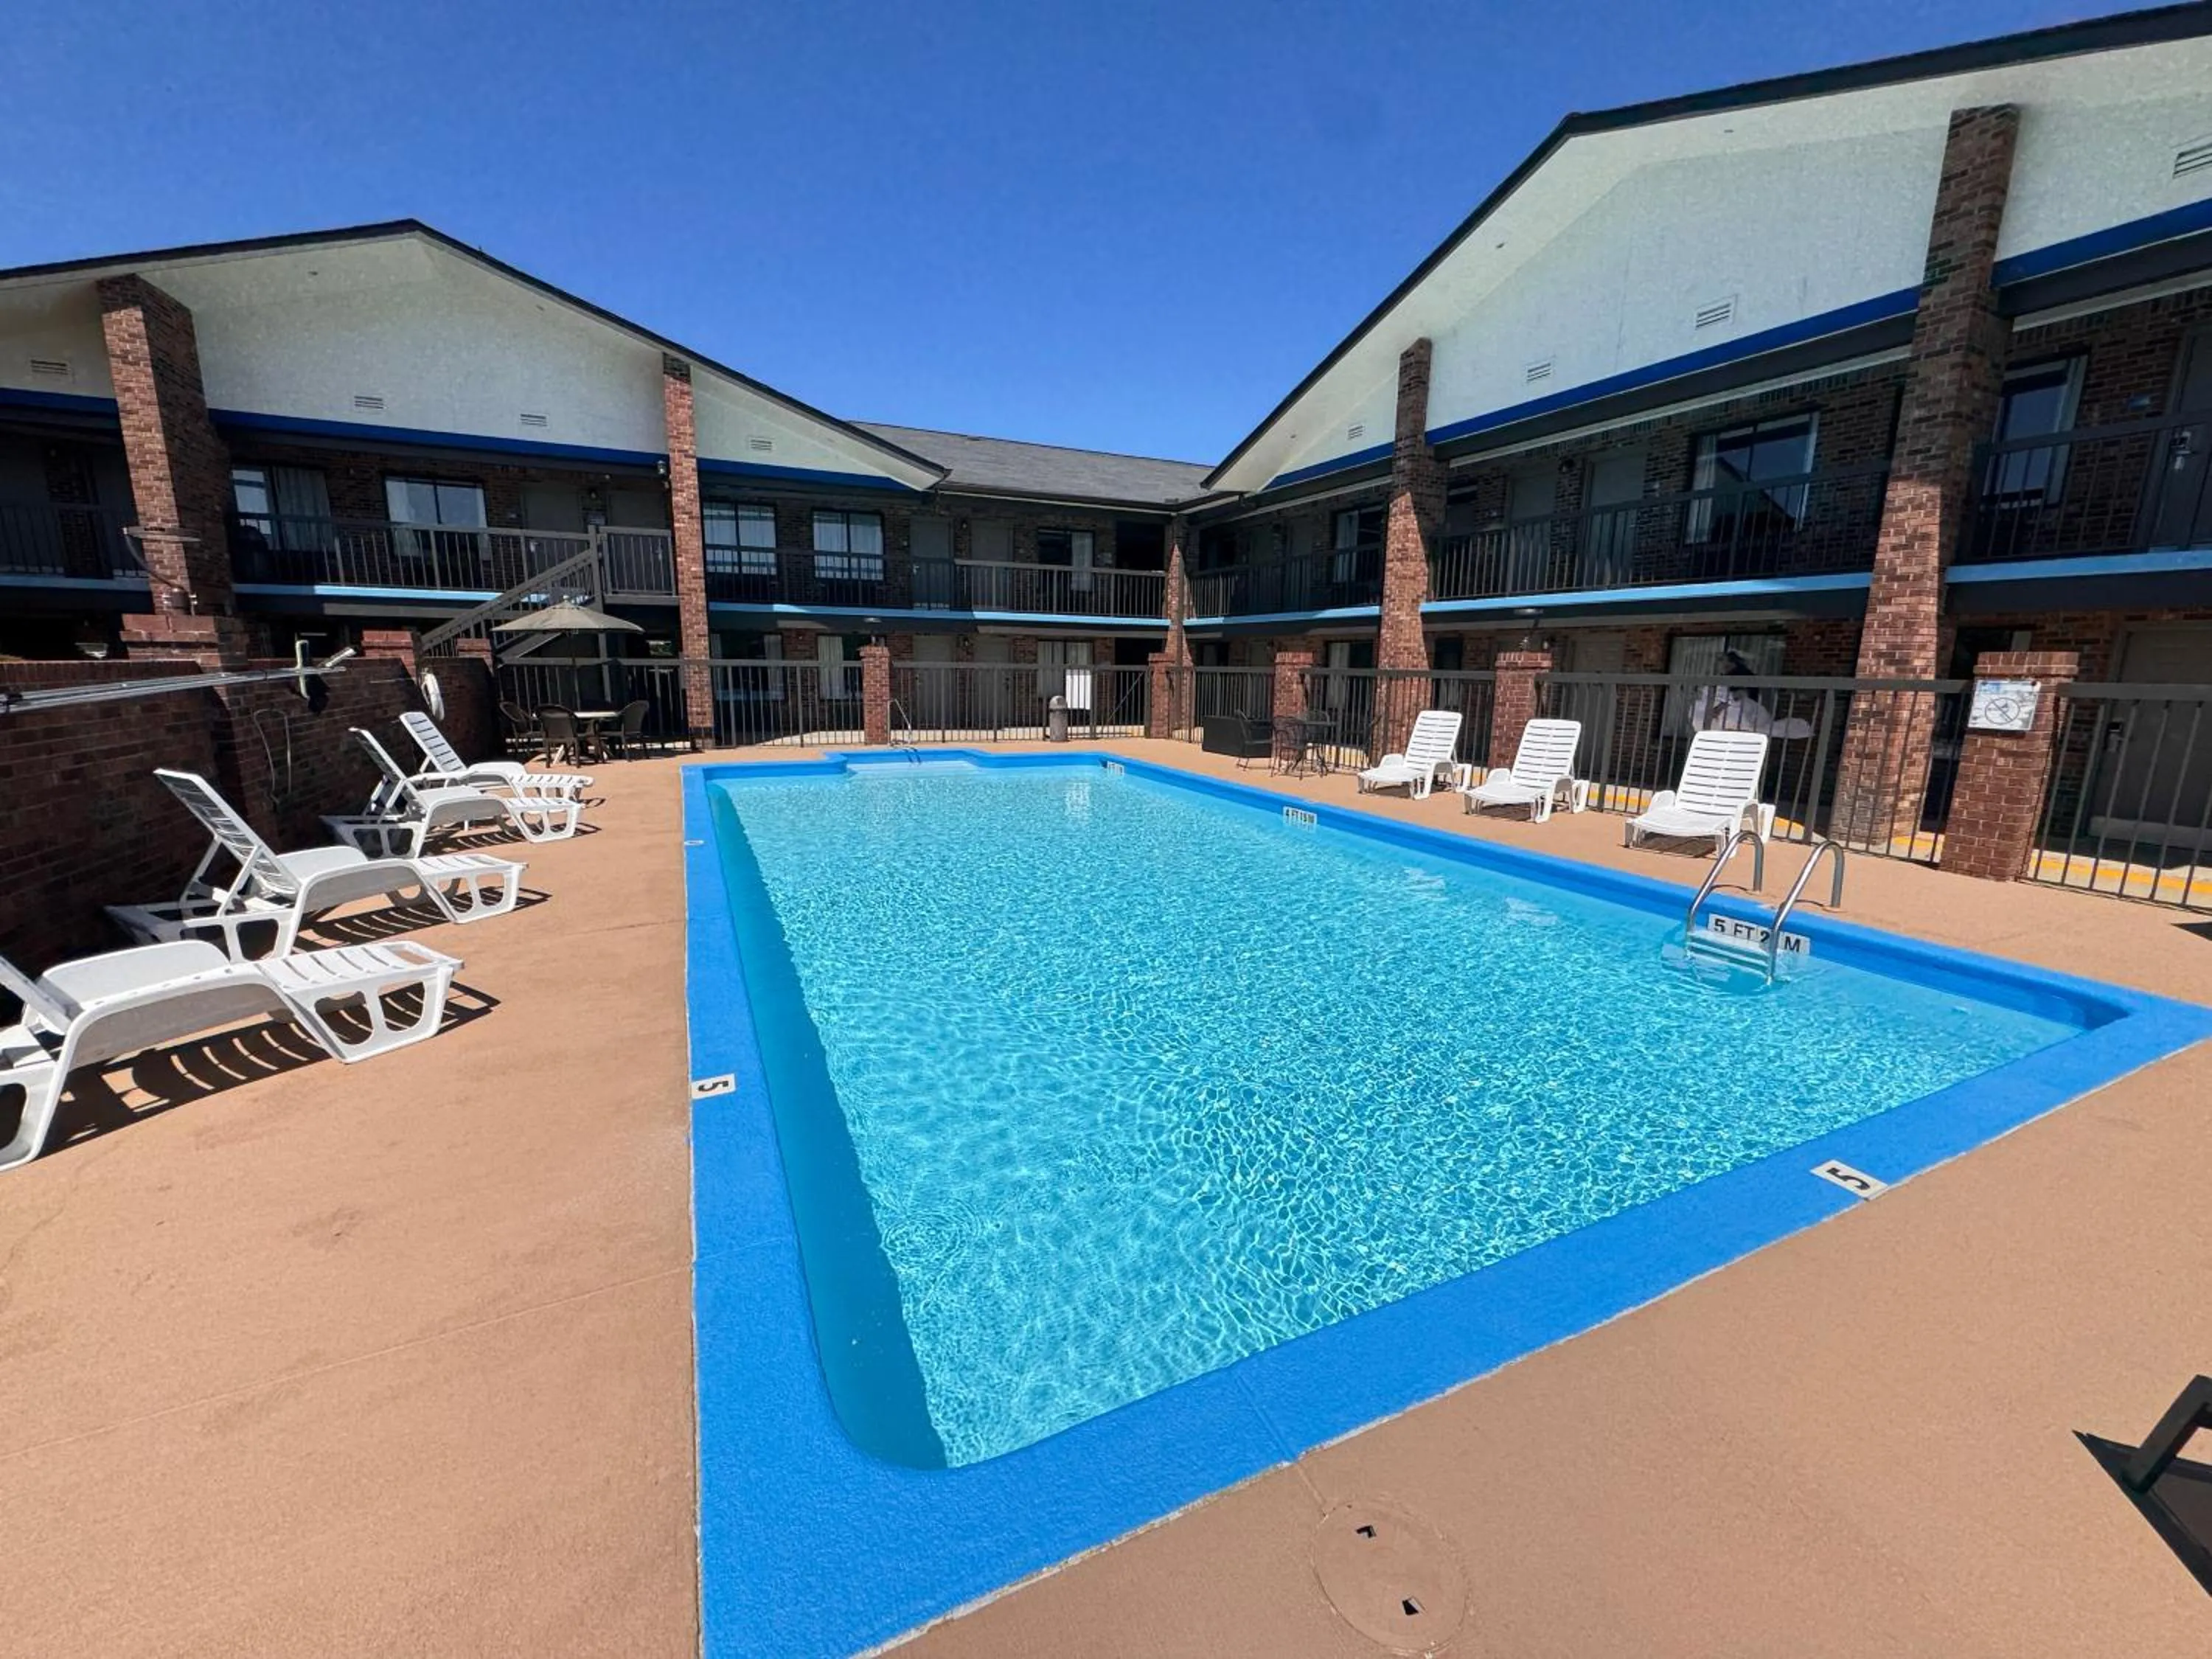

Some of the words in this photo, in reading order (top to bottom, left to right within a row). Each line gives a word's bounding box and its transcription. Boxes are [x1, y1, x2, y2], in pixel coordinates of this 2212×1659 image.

[1714, 918, 1725, 933] 5
[1733, 923, 1755, 939] FT
[1784, 936, 1801, 953] M
[698, 1080, 728, 1092] 5
[1826, 1167, 1871, 1190] 5
